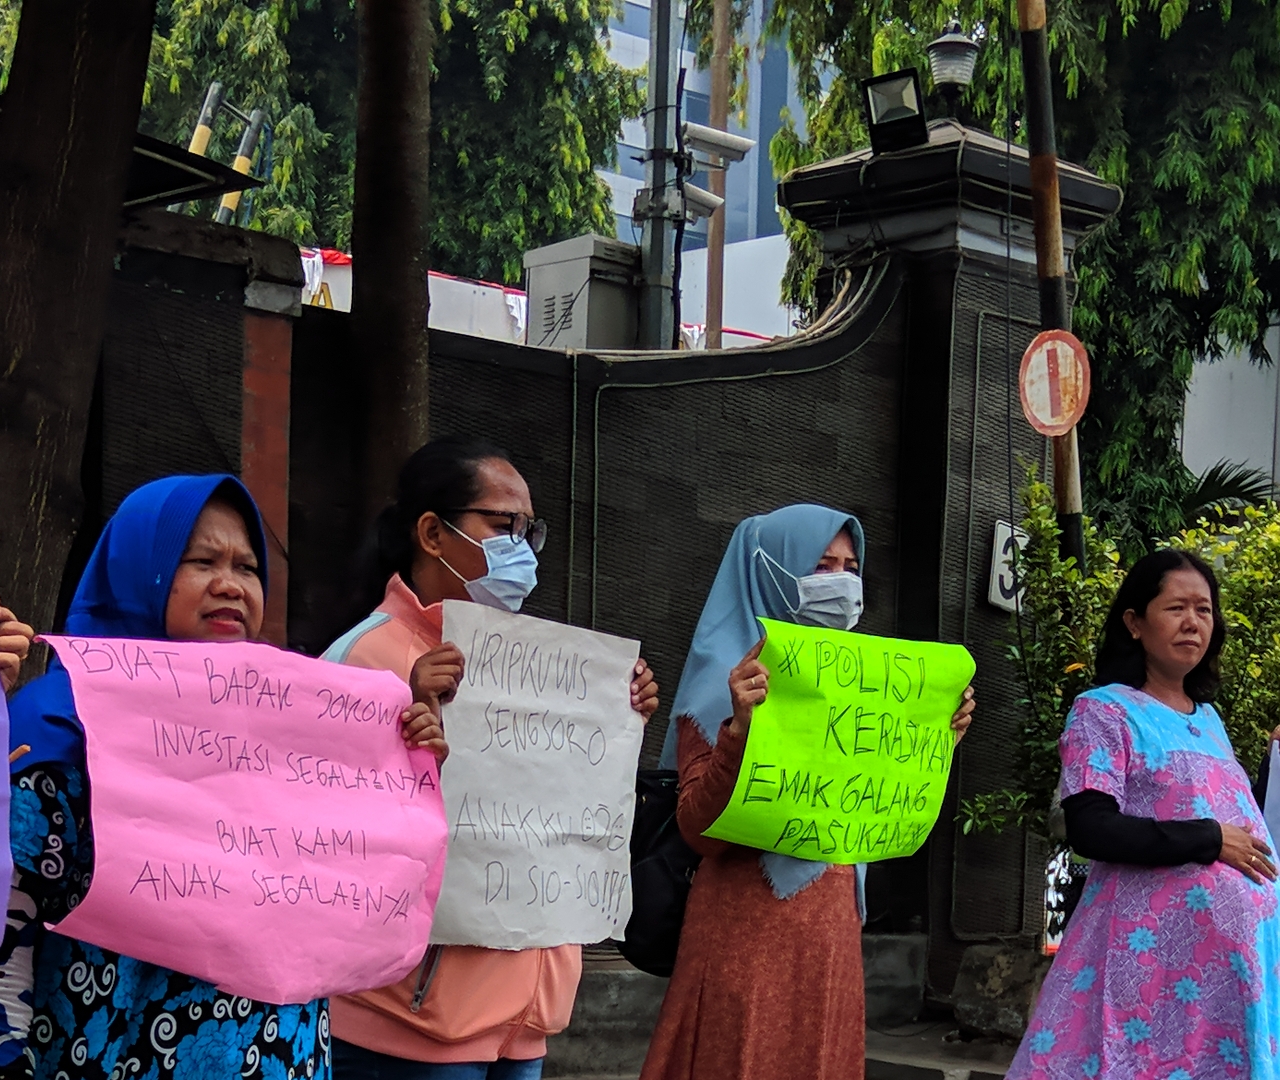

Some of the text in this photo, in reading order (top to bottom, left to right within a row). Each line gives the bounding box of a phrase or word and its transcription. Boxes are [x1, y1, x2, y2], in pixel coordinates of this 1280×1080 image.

[64, 637, 181, 698] BUAT
[204, 657, 293, 711] BAPAK
[153, 719, 272, 775] INVESTASI
[823, 704, 954, 775] KERASUKAN
[742, 762, 930, 815] EMAK GALANG
[216, 819, 367, 860] BUAT KAMI
[129, 861, 231, 901] ANAK
[484, 860, 510, 905] DI
